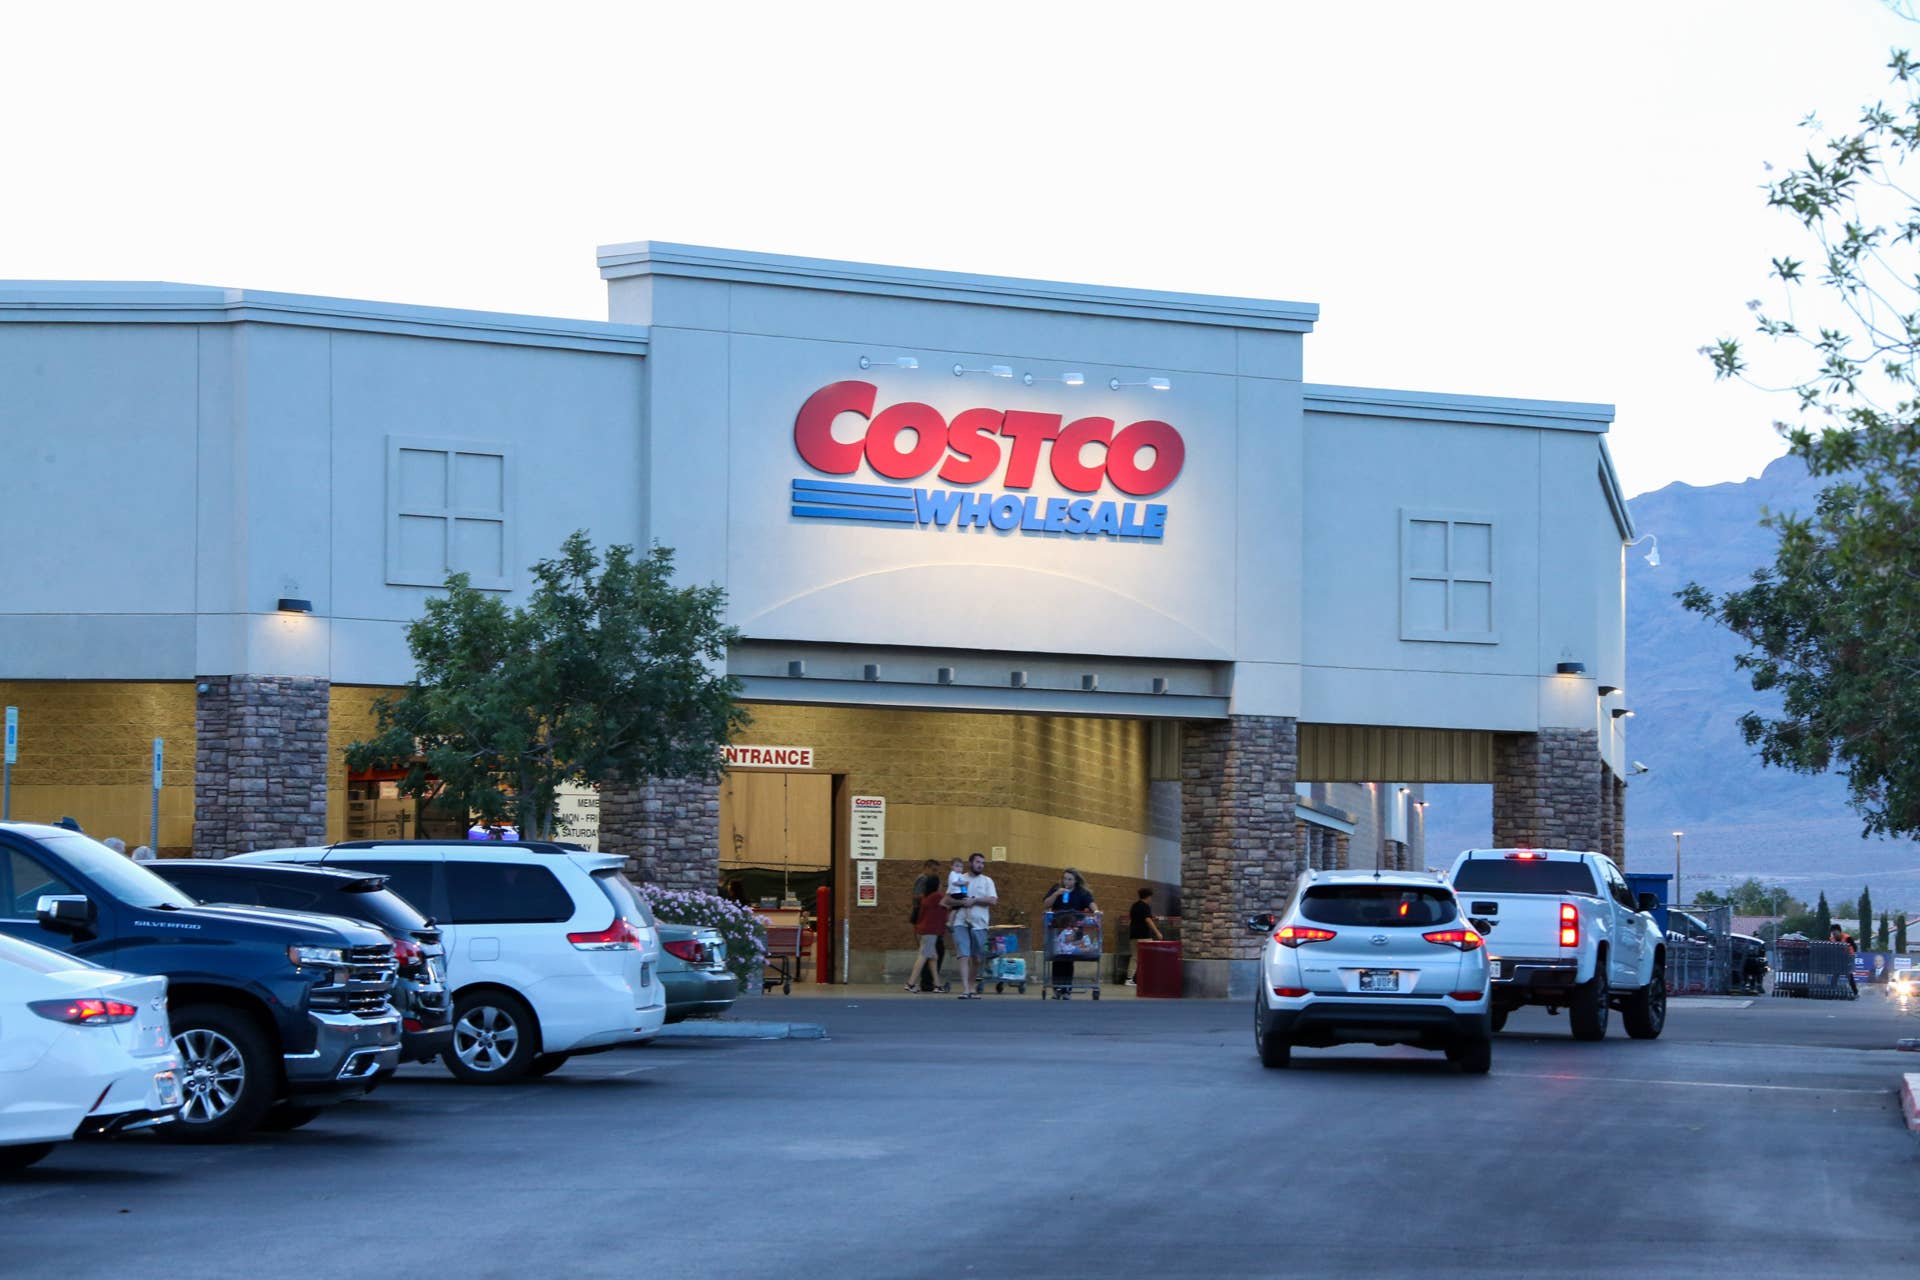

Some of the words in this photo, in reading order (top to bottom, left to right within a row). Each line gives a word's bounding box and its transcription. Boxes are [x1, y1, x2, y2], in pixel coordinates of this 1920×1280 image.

[793, 380, 1185, 496] COSTCO
[914, 488, 1168, 538] WHOLESALE
[562, 828, 599, 838] SATURDA
[134, 920, 201, 929] SILVERADO
